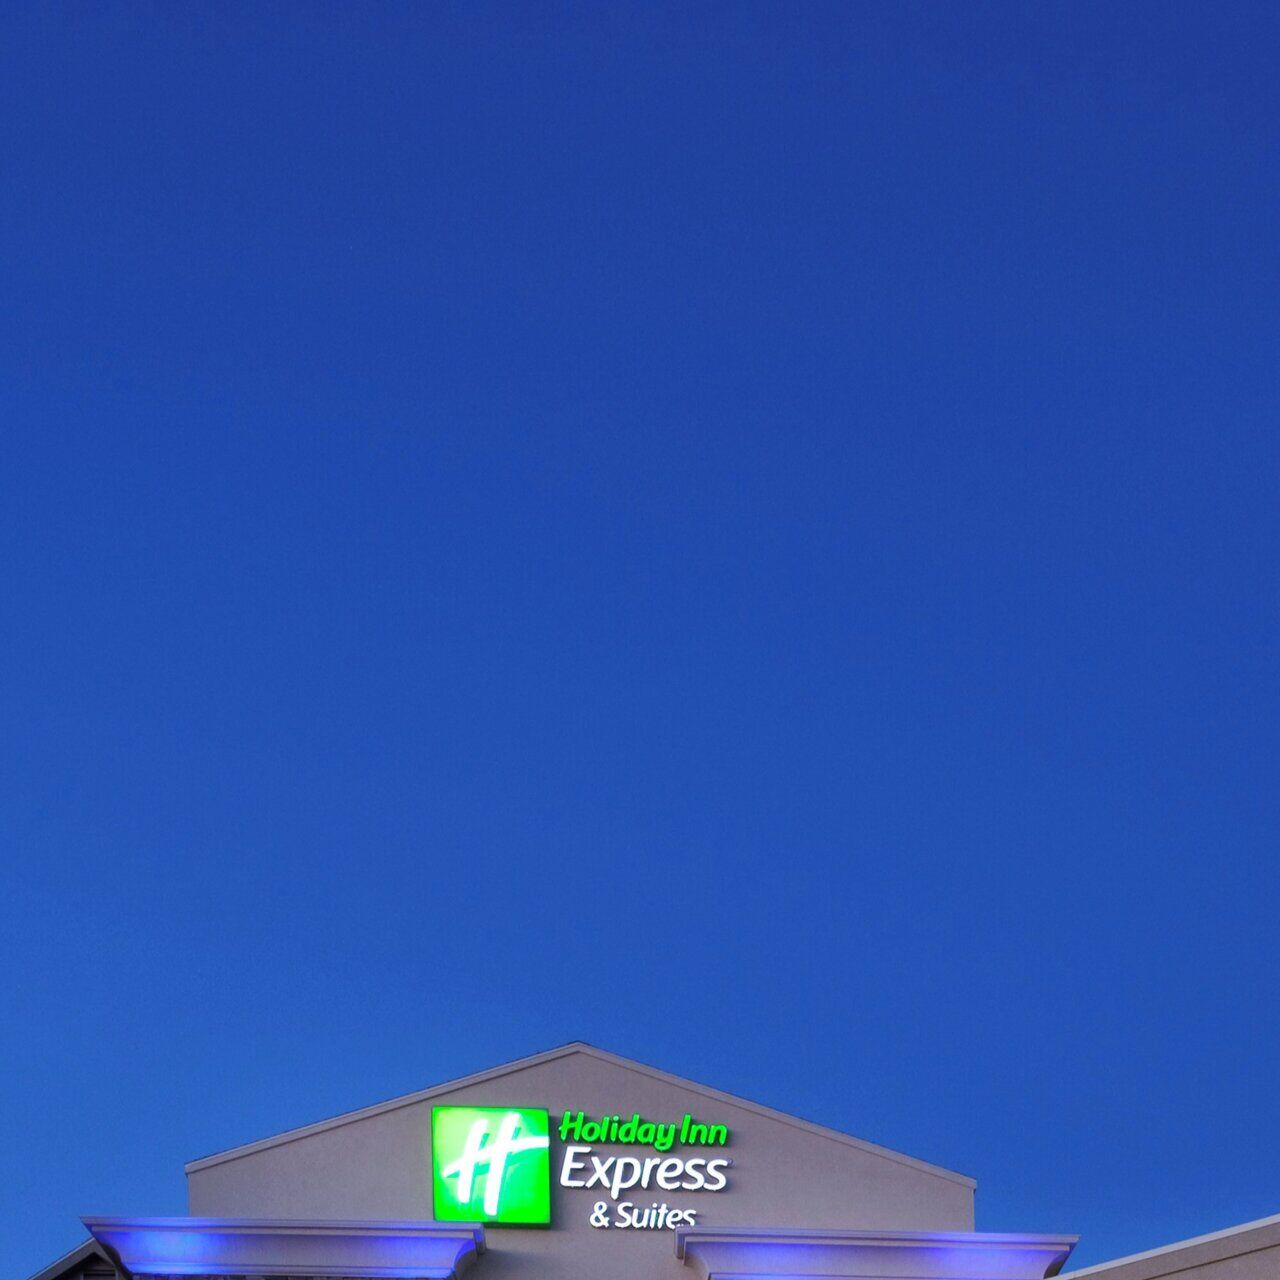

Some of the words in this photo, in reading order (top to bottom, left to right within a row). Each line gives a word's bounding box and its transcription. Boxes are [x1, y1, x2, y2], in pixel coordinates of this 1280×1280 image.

[559, 1111, 676, 1151] Holiday
[680, 1113, 728, 1146] Inn
[560, 1146, 728, 1200] Express
[589, 1201, 610, 1228] &
[614, 1202, 697, 1230] Suites
